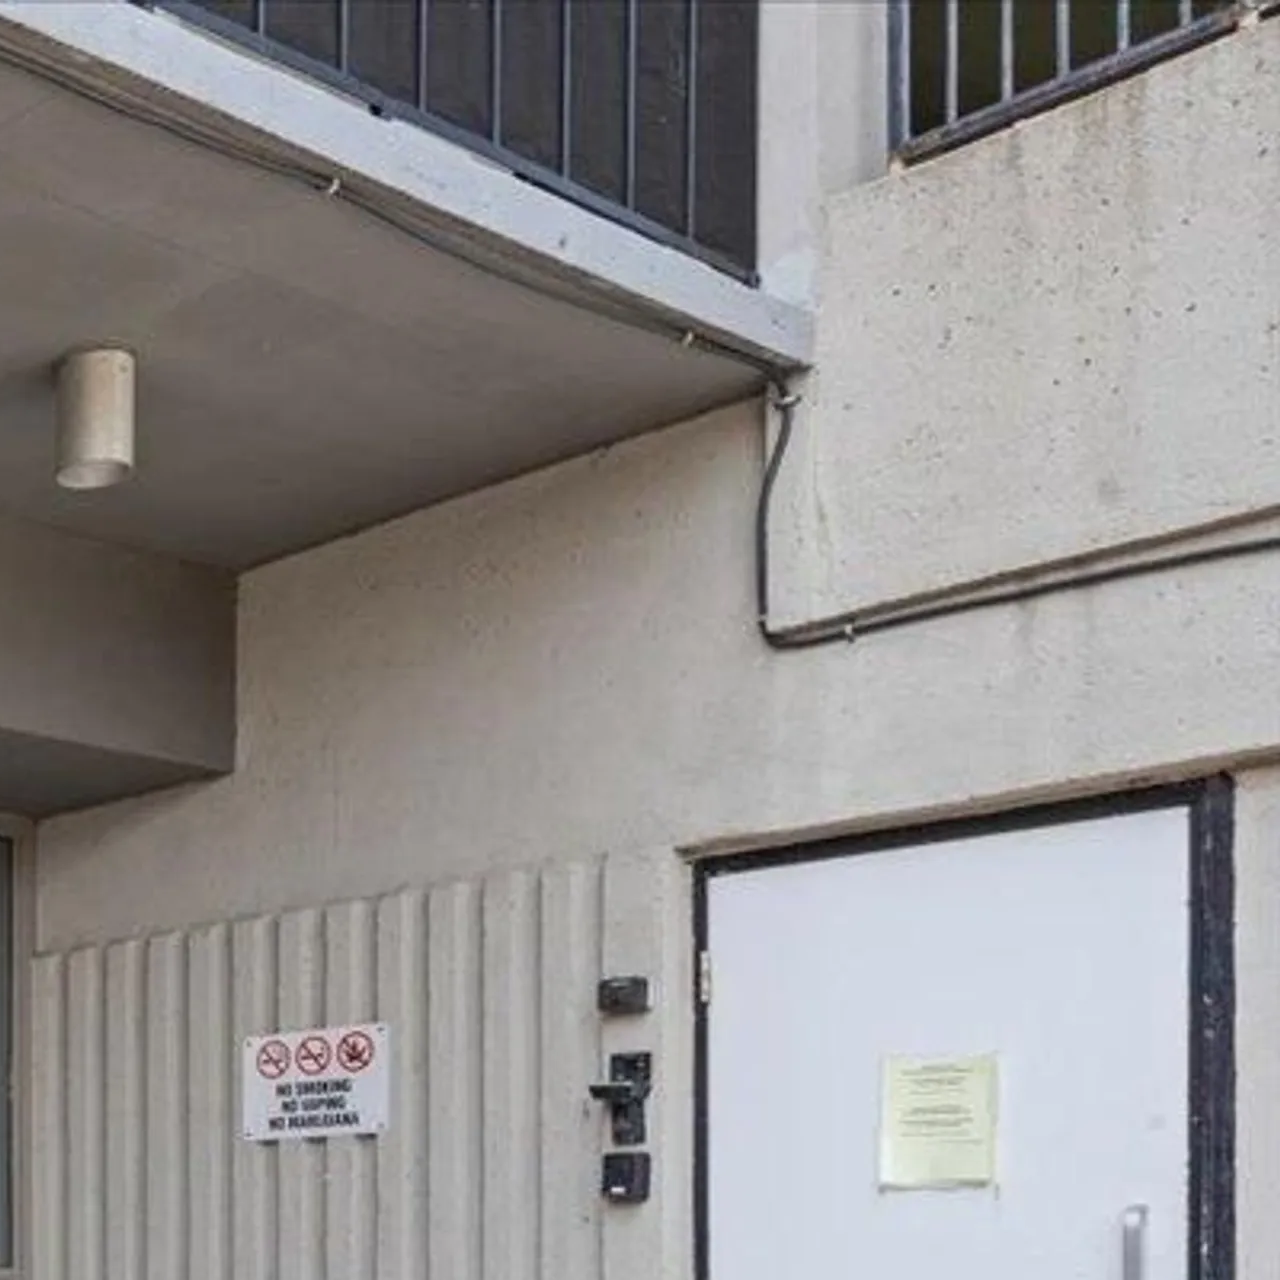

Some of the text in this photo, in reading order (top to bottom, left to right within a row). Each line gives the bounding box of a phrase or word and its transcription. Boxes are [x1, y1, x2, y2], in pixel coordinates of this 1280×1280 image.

[276, 1079, 352, 1096] NO SMOKING
[282, 1099, 297, 1112] NO
[269, 1117, 285, 1130] NO
